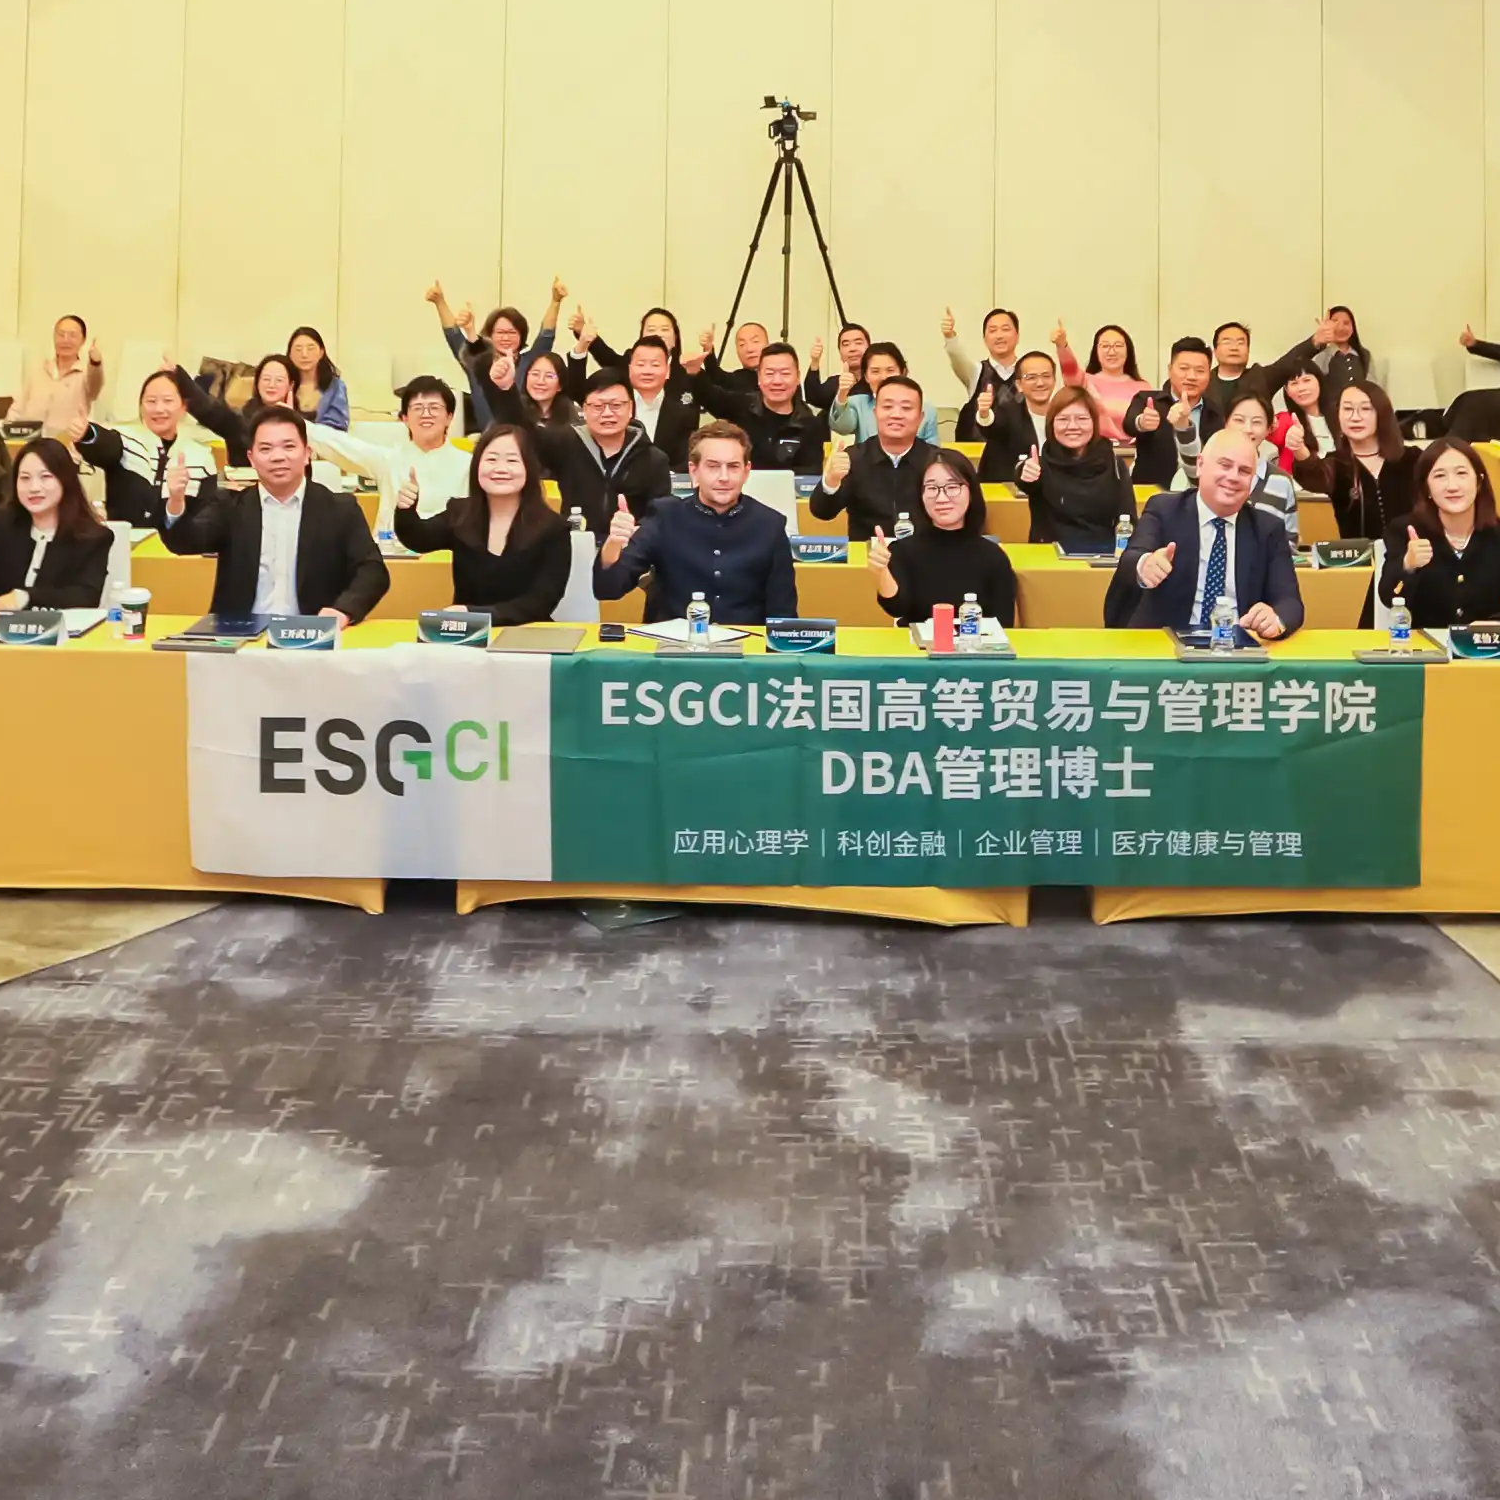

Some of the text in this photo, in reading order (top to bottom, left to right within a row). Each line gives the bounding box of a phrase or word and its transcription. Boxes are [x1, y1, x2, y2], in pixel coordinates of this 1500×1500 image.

[601, 678, 1377, 734] ESGCI法国高等贸易与管理学院
[259, 717, 510, 796] ESGCI
[821, 746, 1155, 800] DBA管理博士
[673, 829, 1303, 858] 应用心理学 科创金融 企业管理 医疗健康与管理
